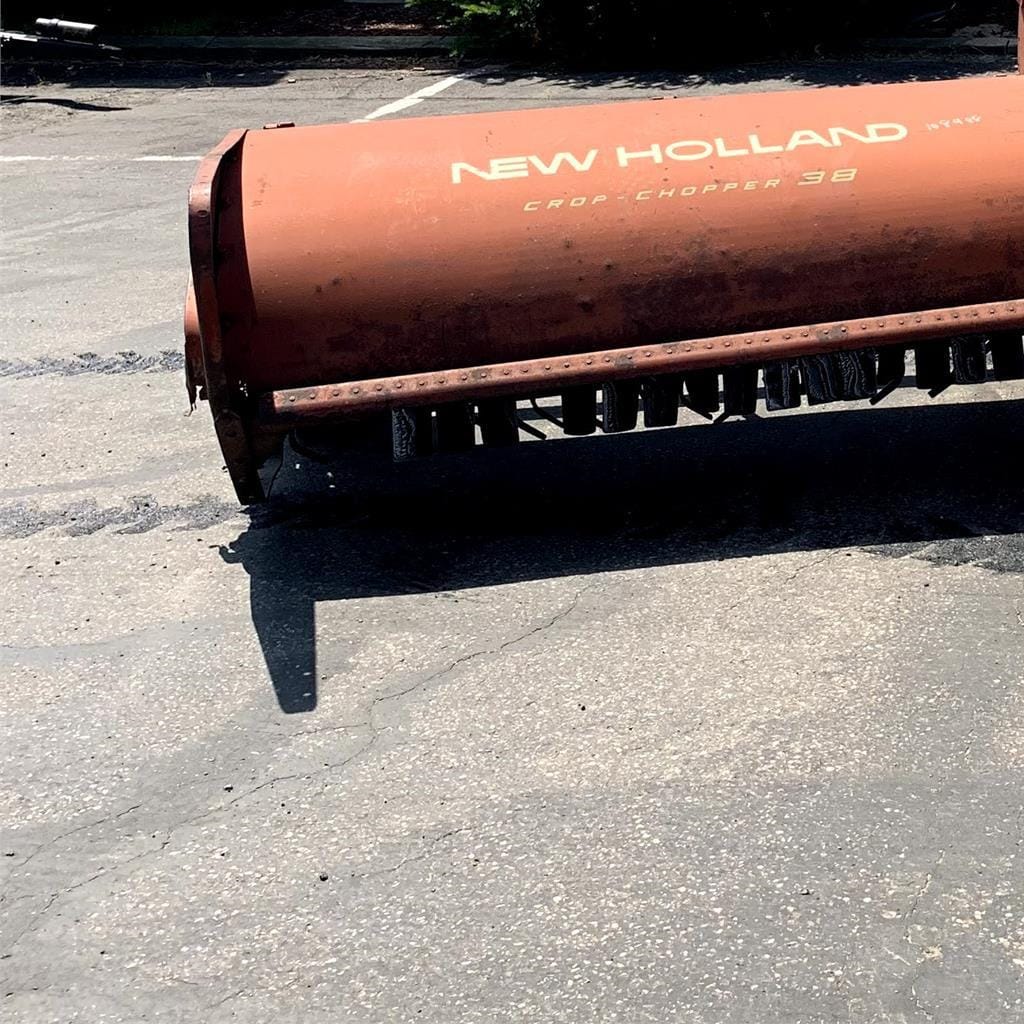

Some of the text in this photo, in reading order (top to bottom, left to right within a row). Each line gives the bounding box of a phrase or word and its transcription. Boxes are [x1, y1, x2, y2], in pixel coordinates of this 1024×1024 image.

[451, 147, 600, 184] NEW
[615, 121, 909, 168] HOLLAND
[796, 167, 860, 188] 38
